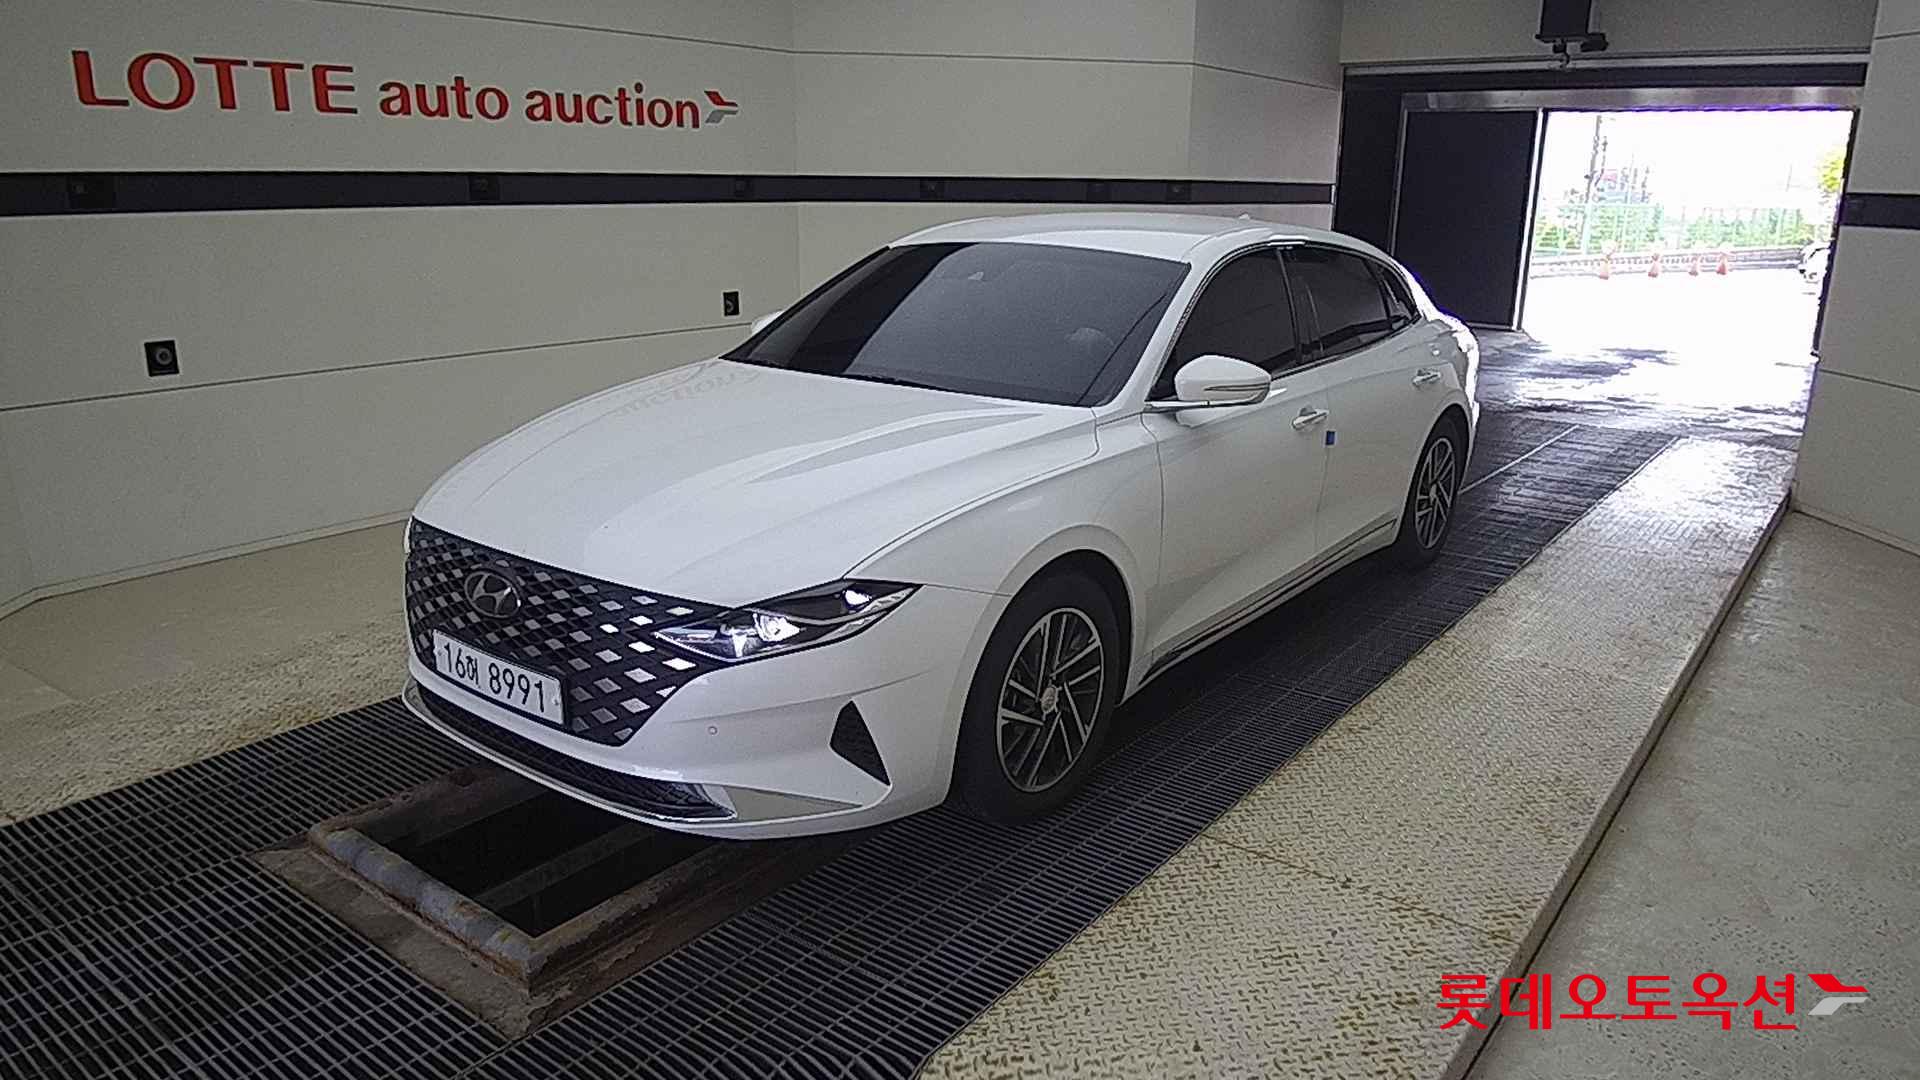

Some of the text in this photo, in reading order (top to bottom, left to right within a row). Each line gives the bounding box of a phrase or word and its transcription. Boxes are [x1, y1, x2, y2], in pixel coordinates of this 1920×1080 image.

[71, 50, 701, 130] LOTTE auto auction
[488, 662, 545, 713] 8991
